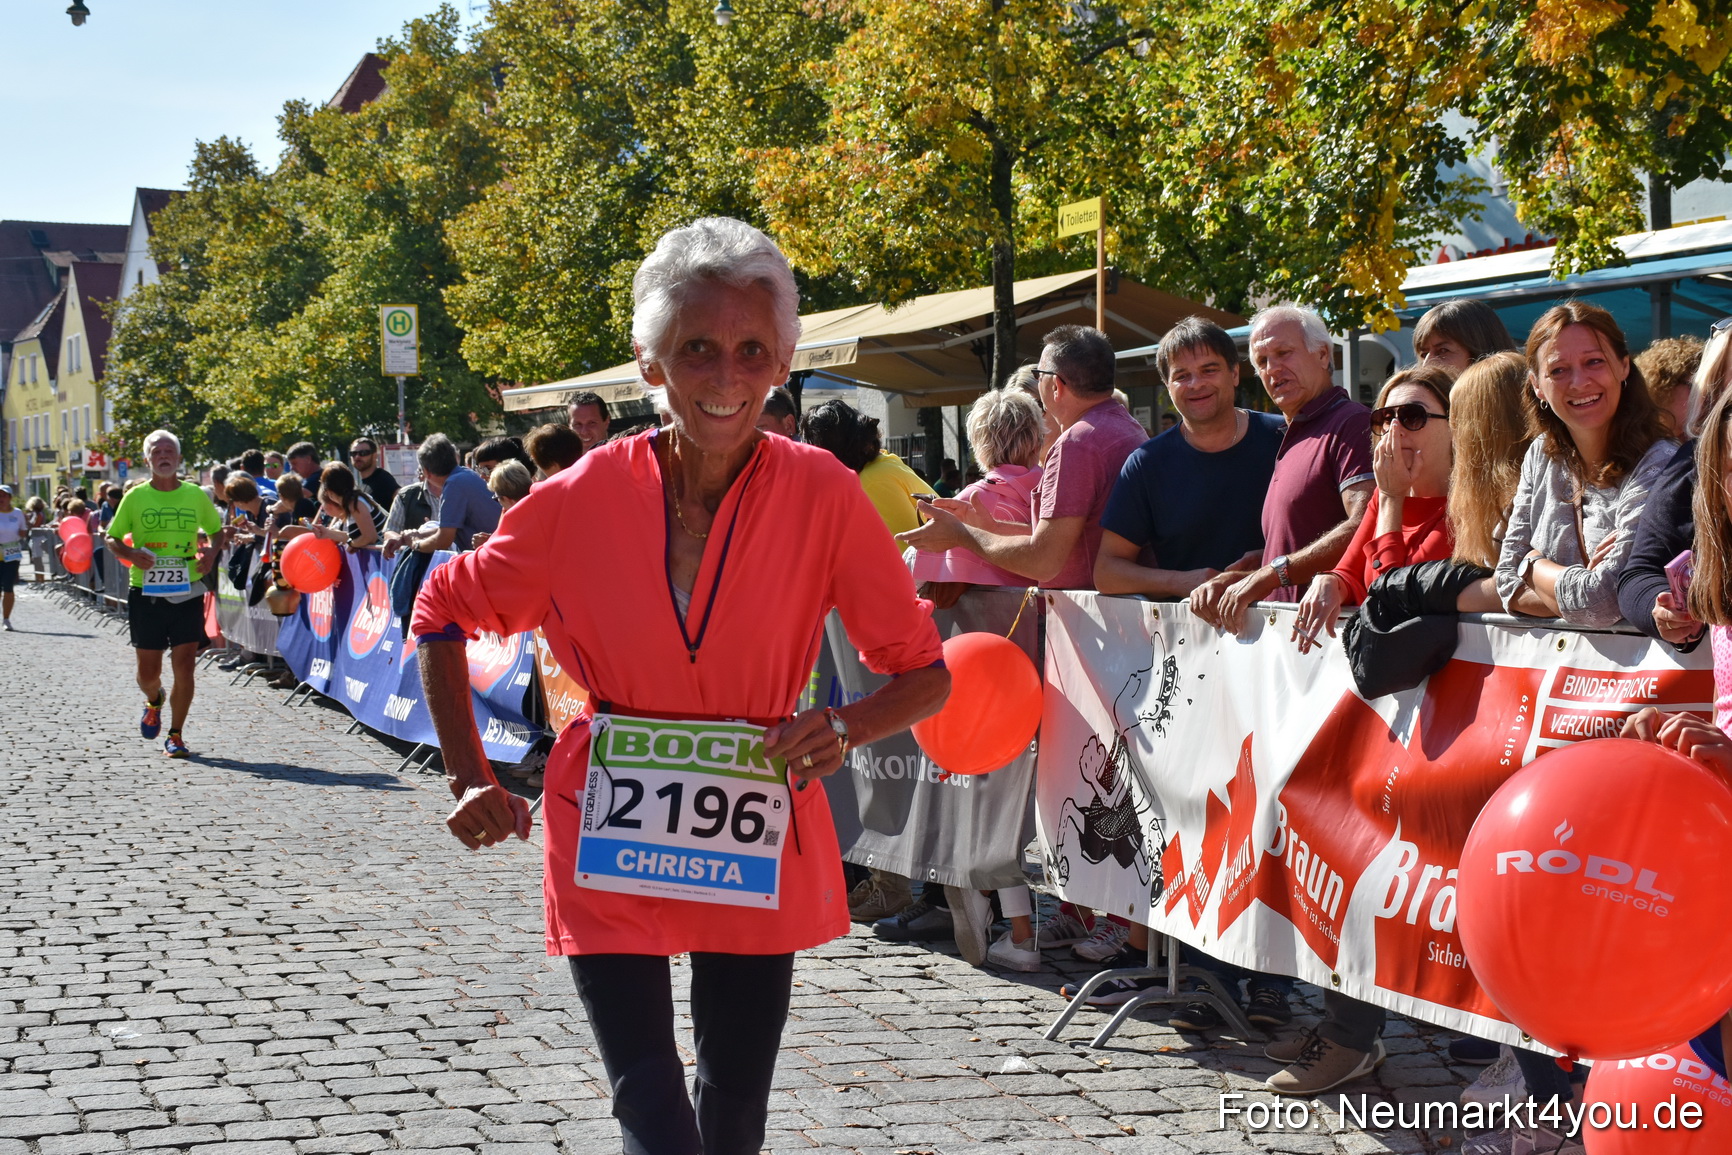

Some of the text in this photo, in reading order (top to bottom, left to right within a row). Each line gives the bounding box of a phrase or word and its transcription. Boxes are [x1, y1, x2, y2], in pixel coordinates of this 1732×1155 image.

[1065, 210, 1098, 227] Toiletten
[393, 316, 406, 330] H
[141, 507, 197, 529] OPF
[148, 570, 184, 583] 2723
[156, 557, 185, 567] OCK
[1562, 675, 1659, 699] BINDESTRICKE
[1500, 695, 1529, 766] Seit 1929
[1550, 712, 1626, 738] VERZURRS
[606, 725, 777, 777] BOCK
[773, 799, 782, 809] D
[1382, 766, 1399, 814] Seit 1929
[607, 778, 768, 843] 2196
[616, 848, 744, 885] CHRISTA
[1264, 799, 1345, 921] Braun
[1375, 838, 1457, 934] Bra
[1581, 883, 1670, 918] energie
[1293, 885, 1341, 947] Sicher ist sicher
[1672, 1077, 1732, 1107] energie
